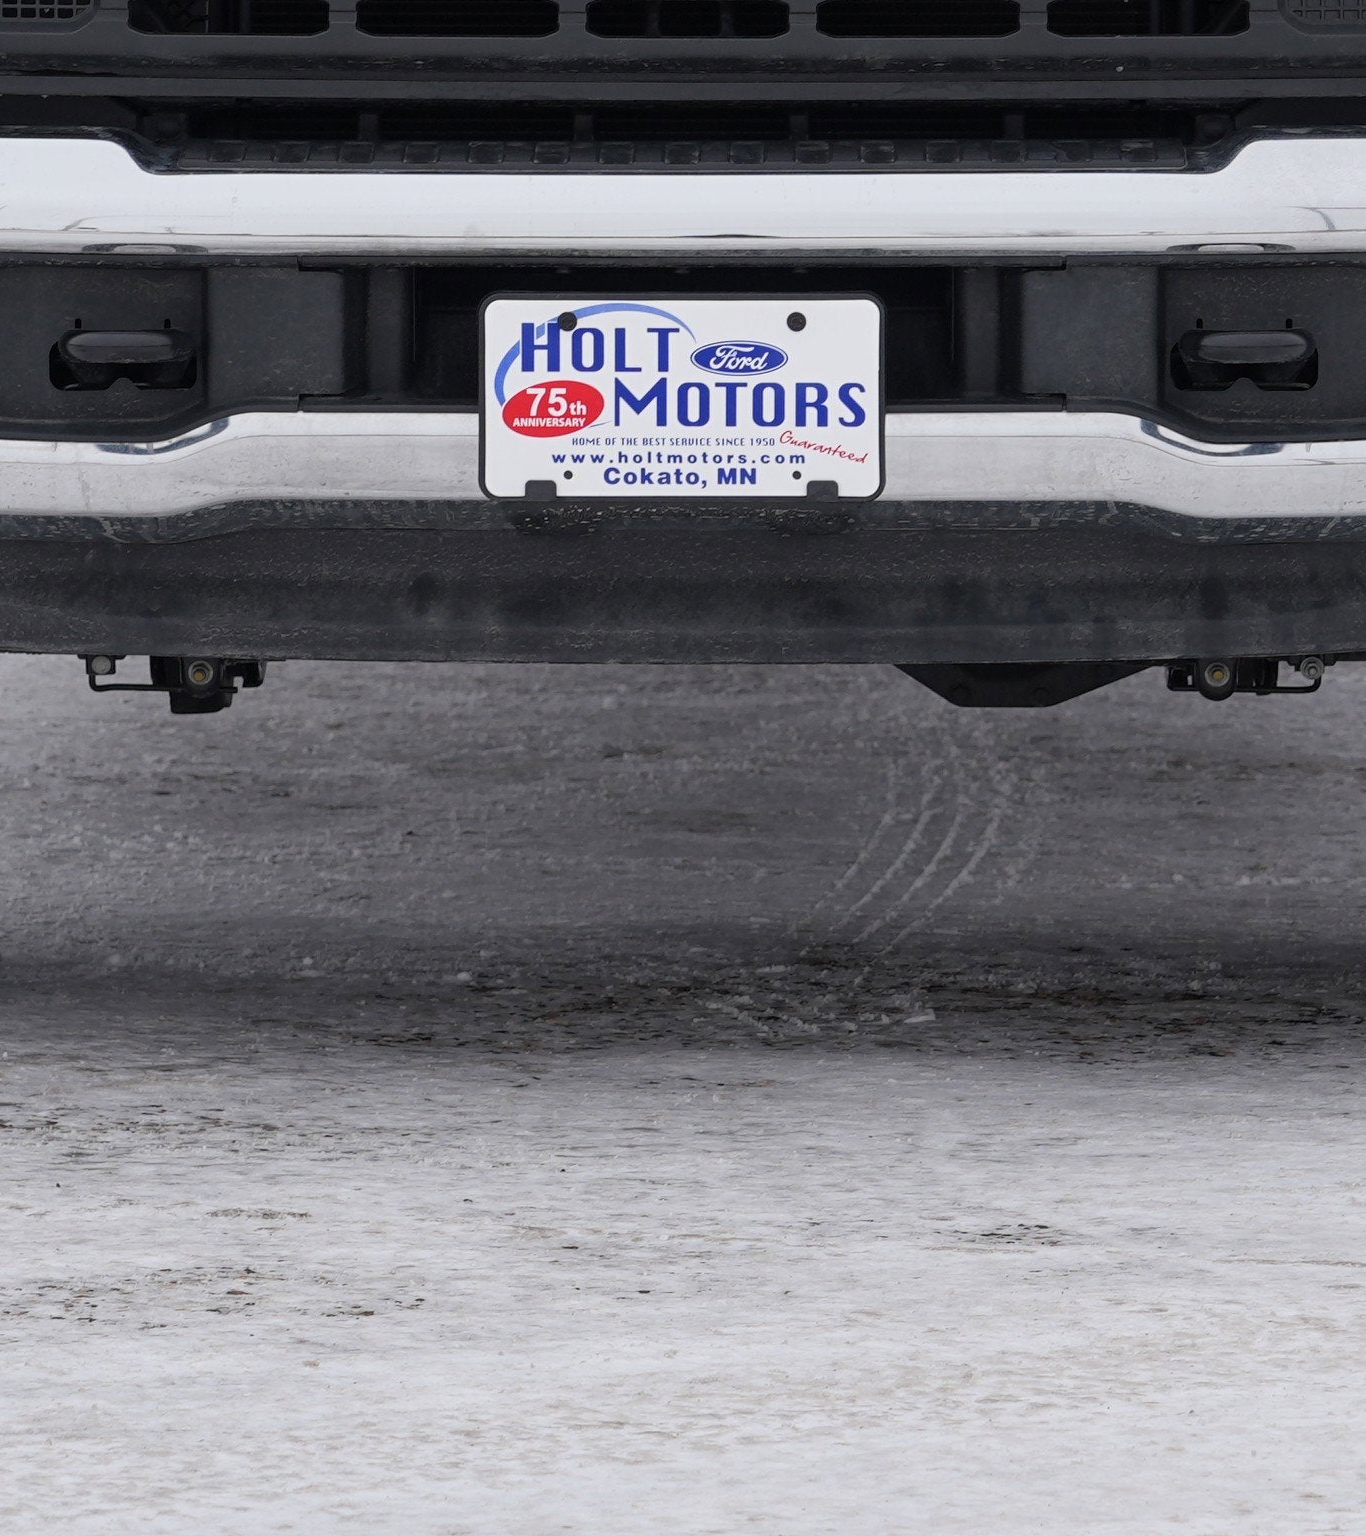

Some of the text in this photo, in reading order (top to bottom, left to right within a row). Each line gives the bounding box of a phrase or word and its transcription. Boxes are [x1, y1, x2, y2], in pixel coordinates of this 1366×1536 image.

[521, 322, 680, 372] HOLT
[709, 345, 770, 370] Ford
[525, 387, 587, 417] 75th
[614, 377, 866, 427] MOTORS
[512, 417, 586, 428] ANNIVERSARY
[571, 437, 601, 446] HOME
[604, 437, 616, 446] OF
[620, 437, 639, 446] THE
[642, 437, 666, 446] BEST
[715, 437, 745, 446] SINCE
[750, 437, 775, 446] 1950
[779, 430, 870, 464] Guaranteed
[551, 451, 805, 464] www.holtmotors.com
[603, 467, 757, 489] Cokato, MN
